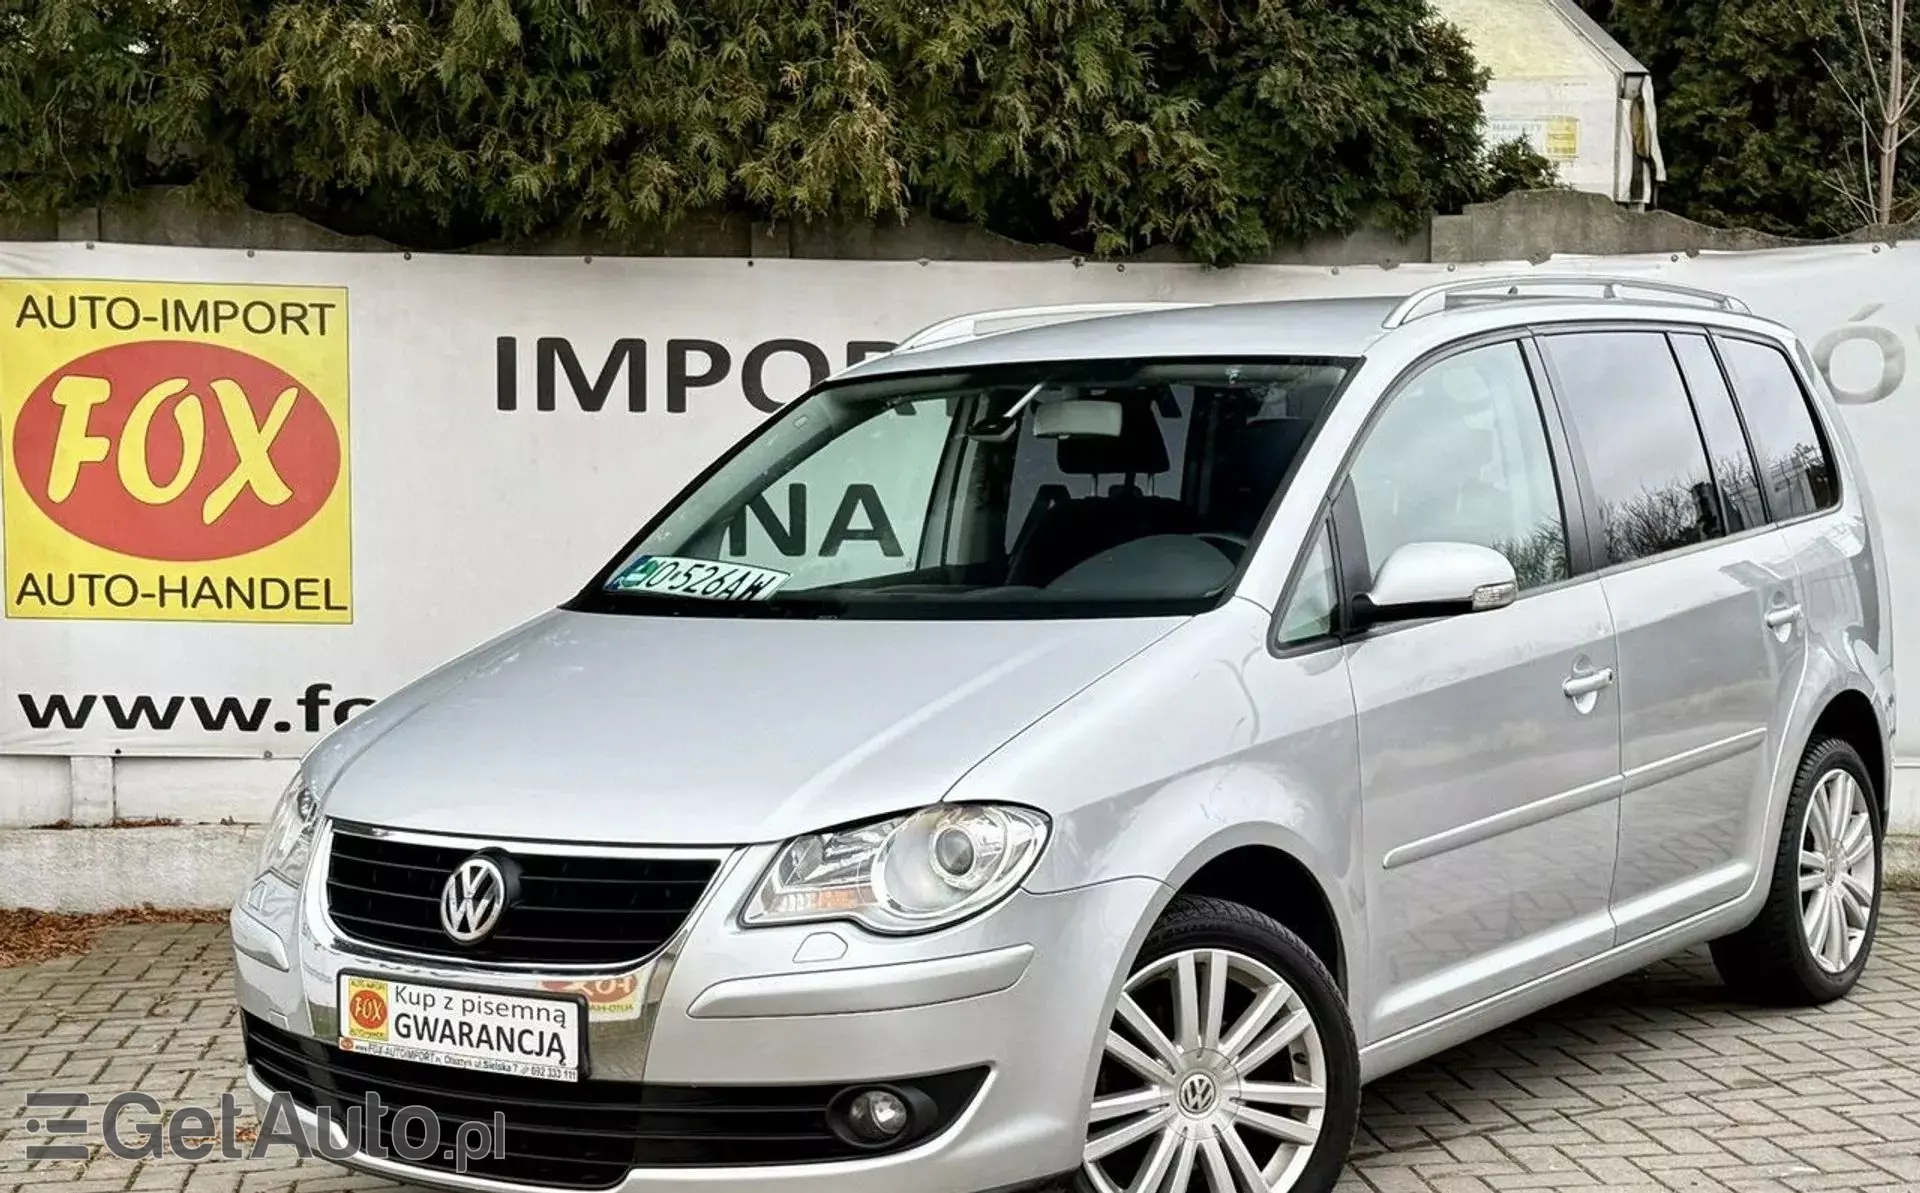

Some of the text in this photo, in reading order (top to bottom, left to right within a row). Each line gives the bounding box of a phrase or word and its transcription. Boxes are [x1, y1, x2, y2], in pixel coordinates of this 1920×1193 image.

[14, 294, 337, 337] AUTO-IMPORT
[496, 335, 905, 415] IMPO
[46, 374, 300, 526] FOX
[728, 482, 905, 558] NA
[14, 572, 348, 613] AUTO-HANDEL
[355, 996, 383, 1022] FOX
[395, 984, 567, 1029] Kup z pisemną
[394, 1012, 567, 1066] GWARANCJĄ
